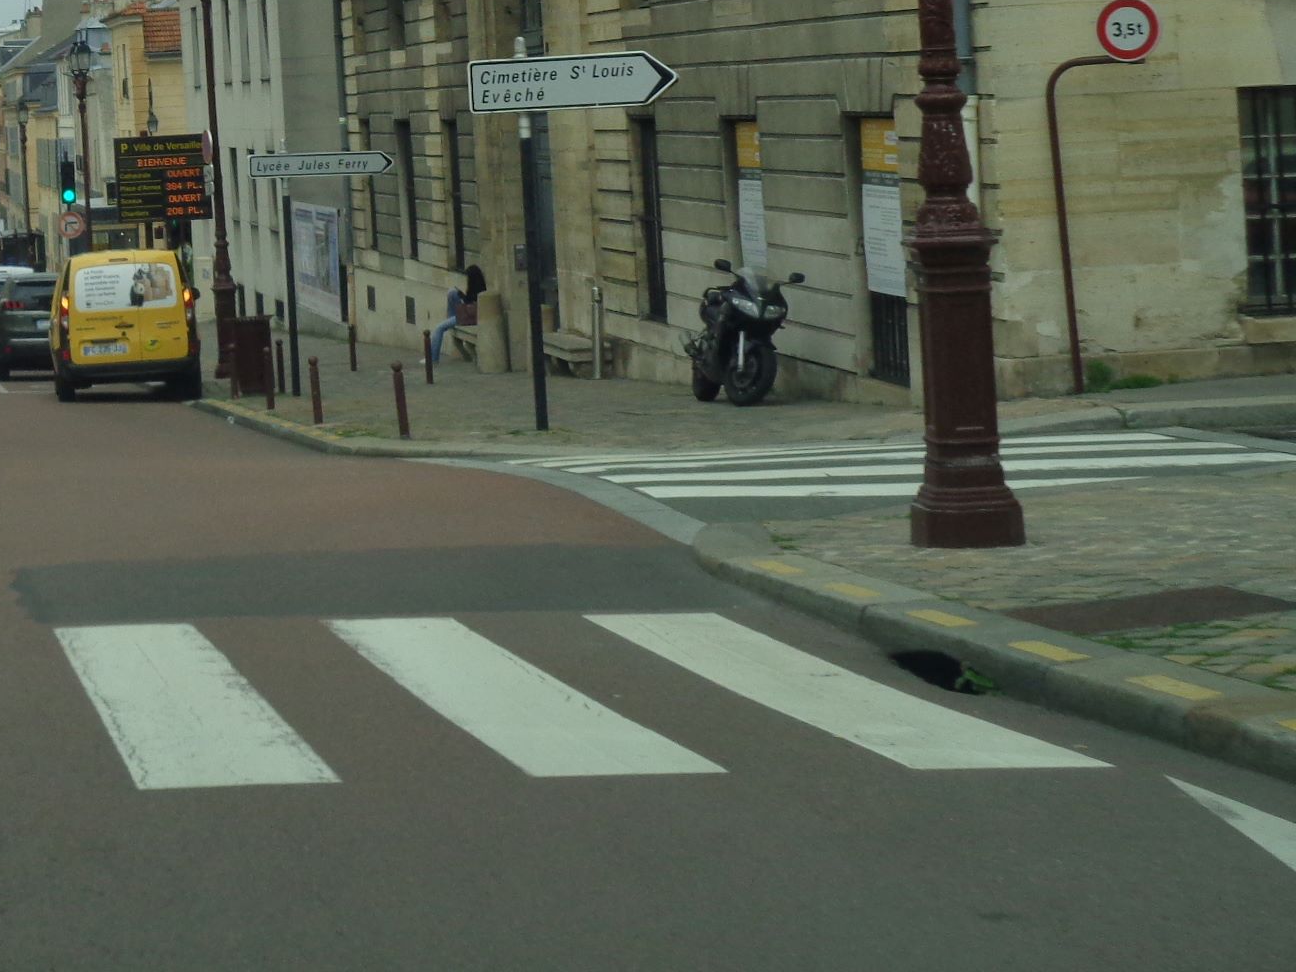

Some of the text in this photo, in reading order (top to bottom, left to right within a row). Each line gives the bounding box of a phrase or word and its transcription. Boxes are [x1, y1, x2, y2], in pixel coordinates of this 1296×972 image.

[1112, 21, 1144, 39] 3,5t
[480, 68, 558, 85] Cimetière
[592, 62, 634, 78] Louis
[482, 87, 545, 104] Evêché
[133, 143, 151, 151] Ville
[153, 142, 164, 151] de
[137, 156, 187, 167] BIENVENUE
[256, 158, 368, 173] Lycée Jules Ferry
[167, 168, 201, 178] OUVERT
[169, 193, 201, 203] OUVERT
